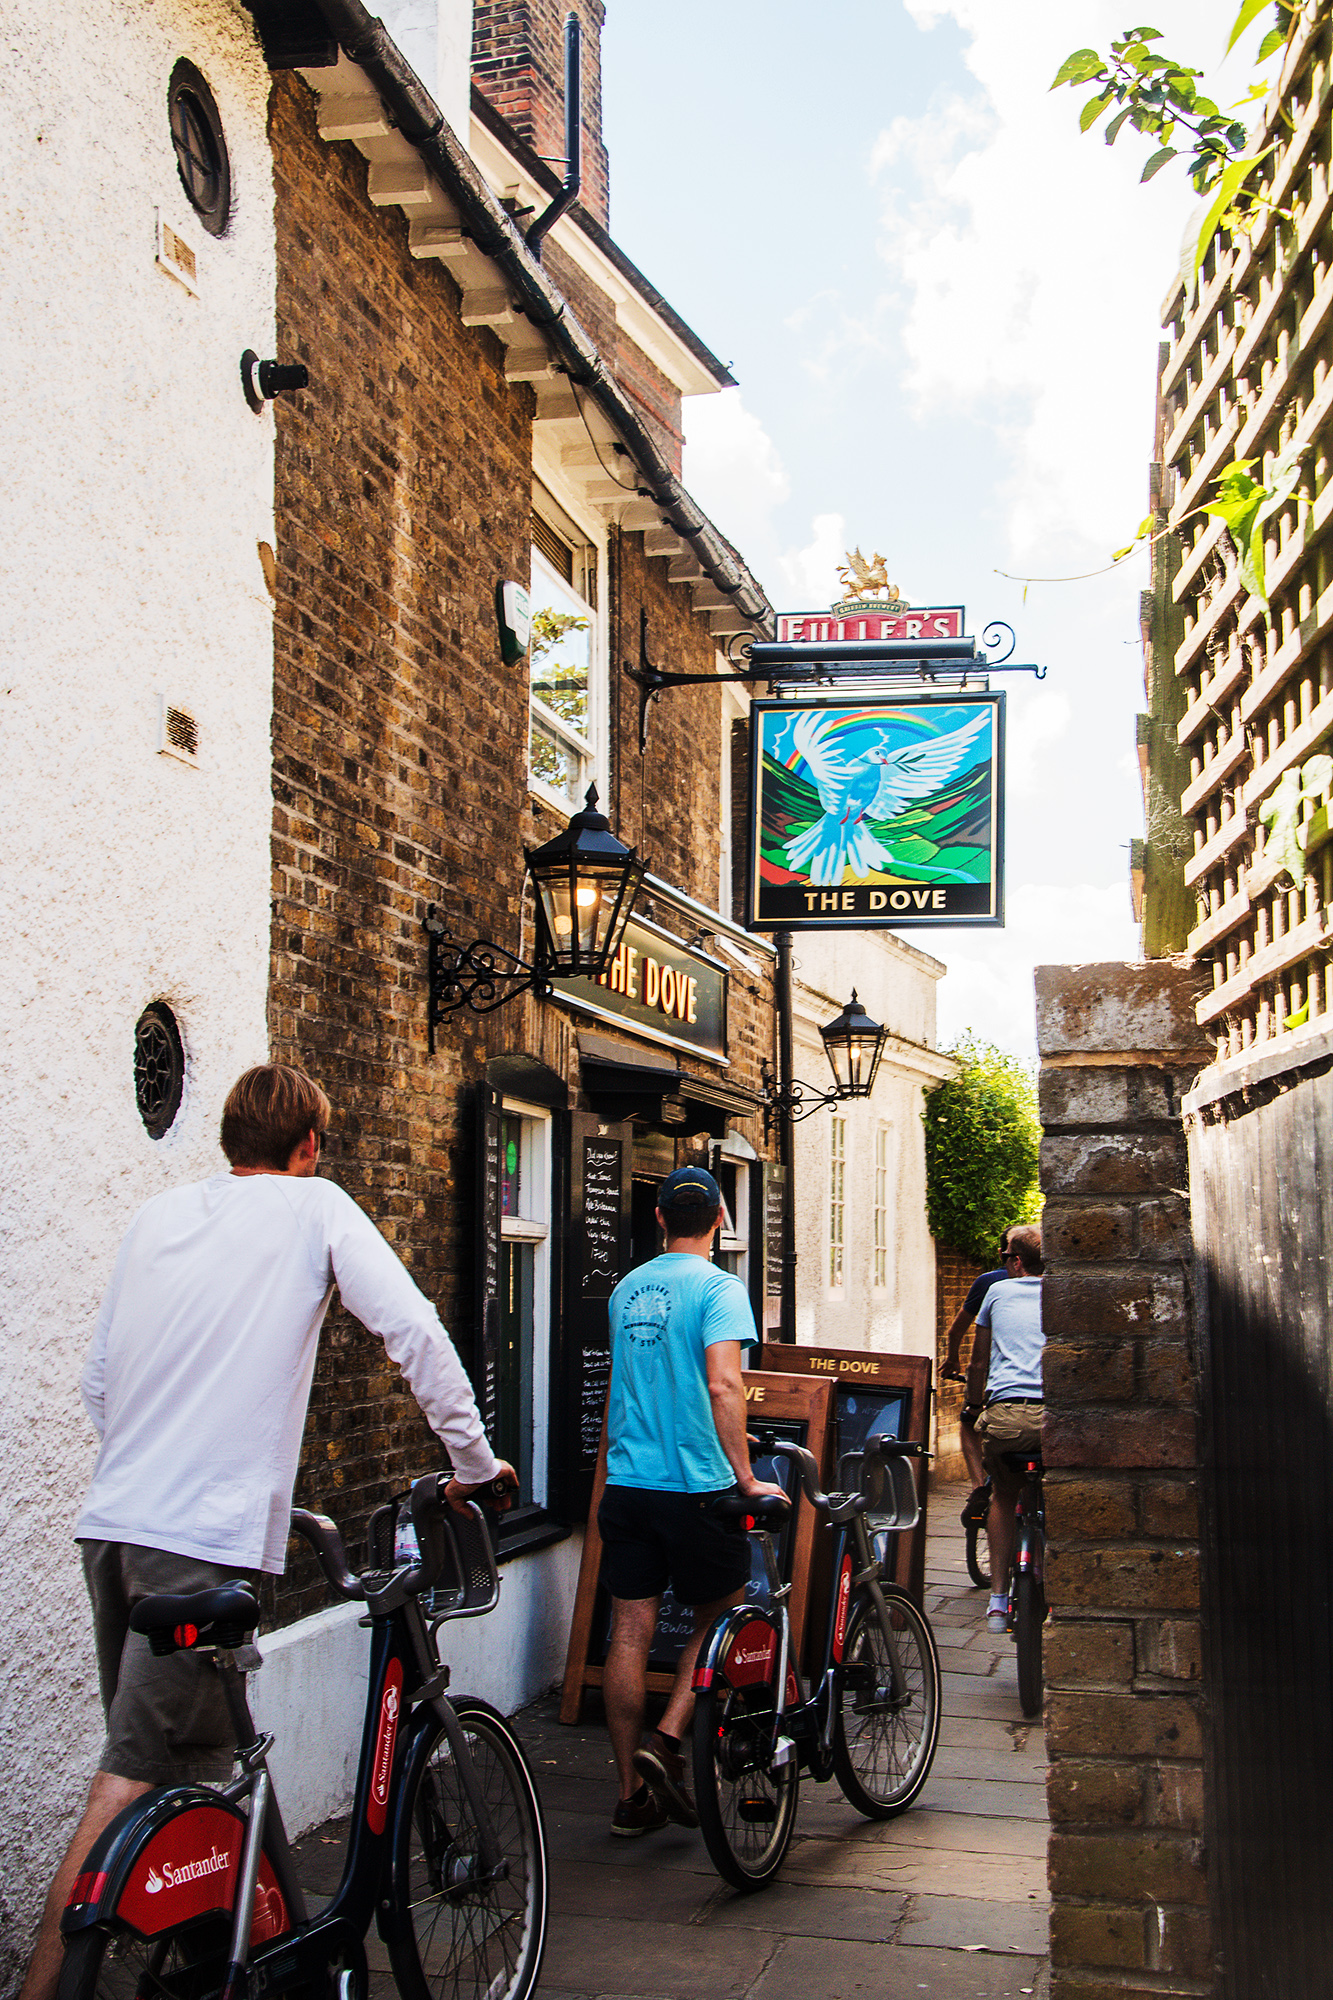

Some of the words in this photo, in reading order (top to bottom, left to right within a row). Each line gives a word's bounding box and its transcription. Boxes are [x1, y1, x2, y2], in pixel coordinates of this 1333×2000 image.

[803, 891, 855, 911] THE
[869, 889, 947, 910] DOVE
[597, 942, 638, 999] HE
[642, 956, 698, 1024] DOVE
[808, 1357, 836, 1371] THE
[839, 1360, 881, 1375] DOVE
[743, 1385, 767, 1402] VE
[742, 1643, 772, 1665] Santander
[378, 1722, 394, 1784] Santander
[162, 1846, 231, 1889] Santander
